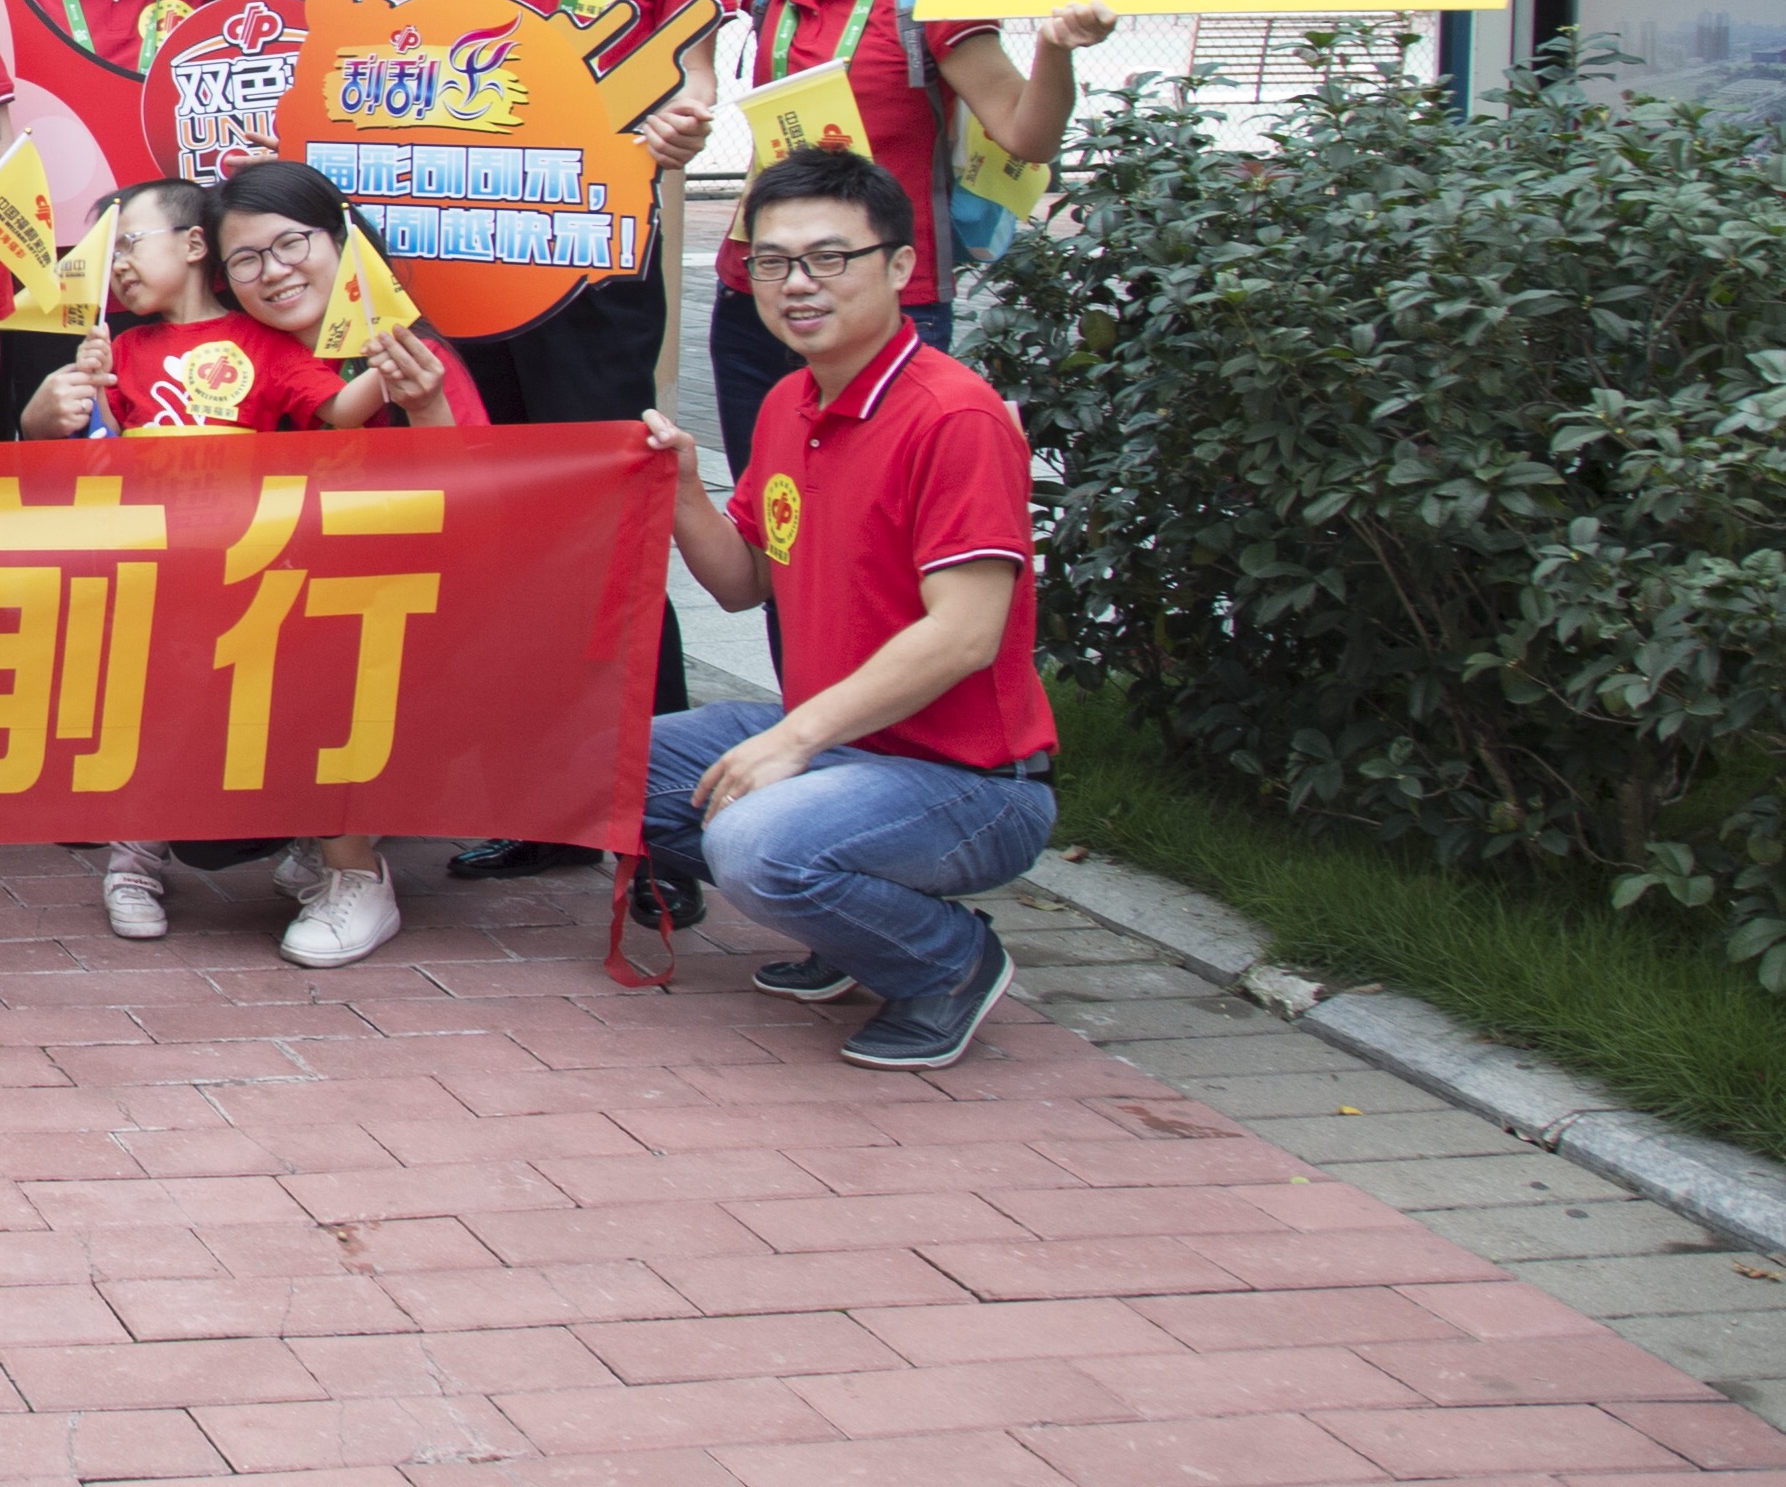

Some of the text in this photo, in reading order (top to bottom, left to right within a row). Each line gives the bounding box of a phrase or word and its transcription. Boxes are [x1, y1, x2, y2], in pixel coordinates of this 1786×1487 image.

[173, 54, 300, 116] 双色
[305, 141, 608, 212] 福彩刮刮乐，
